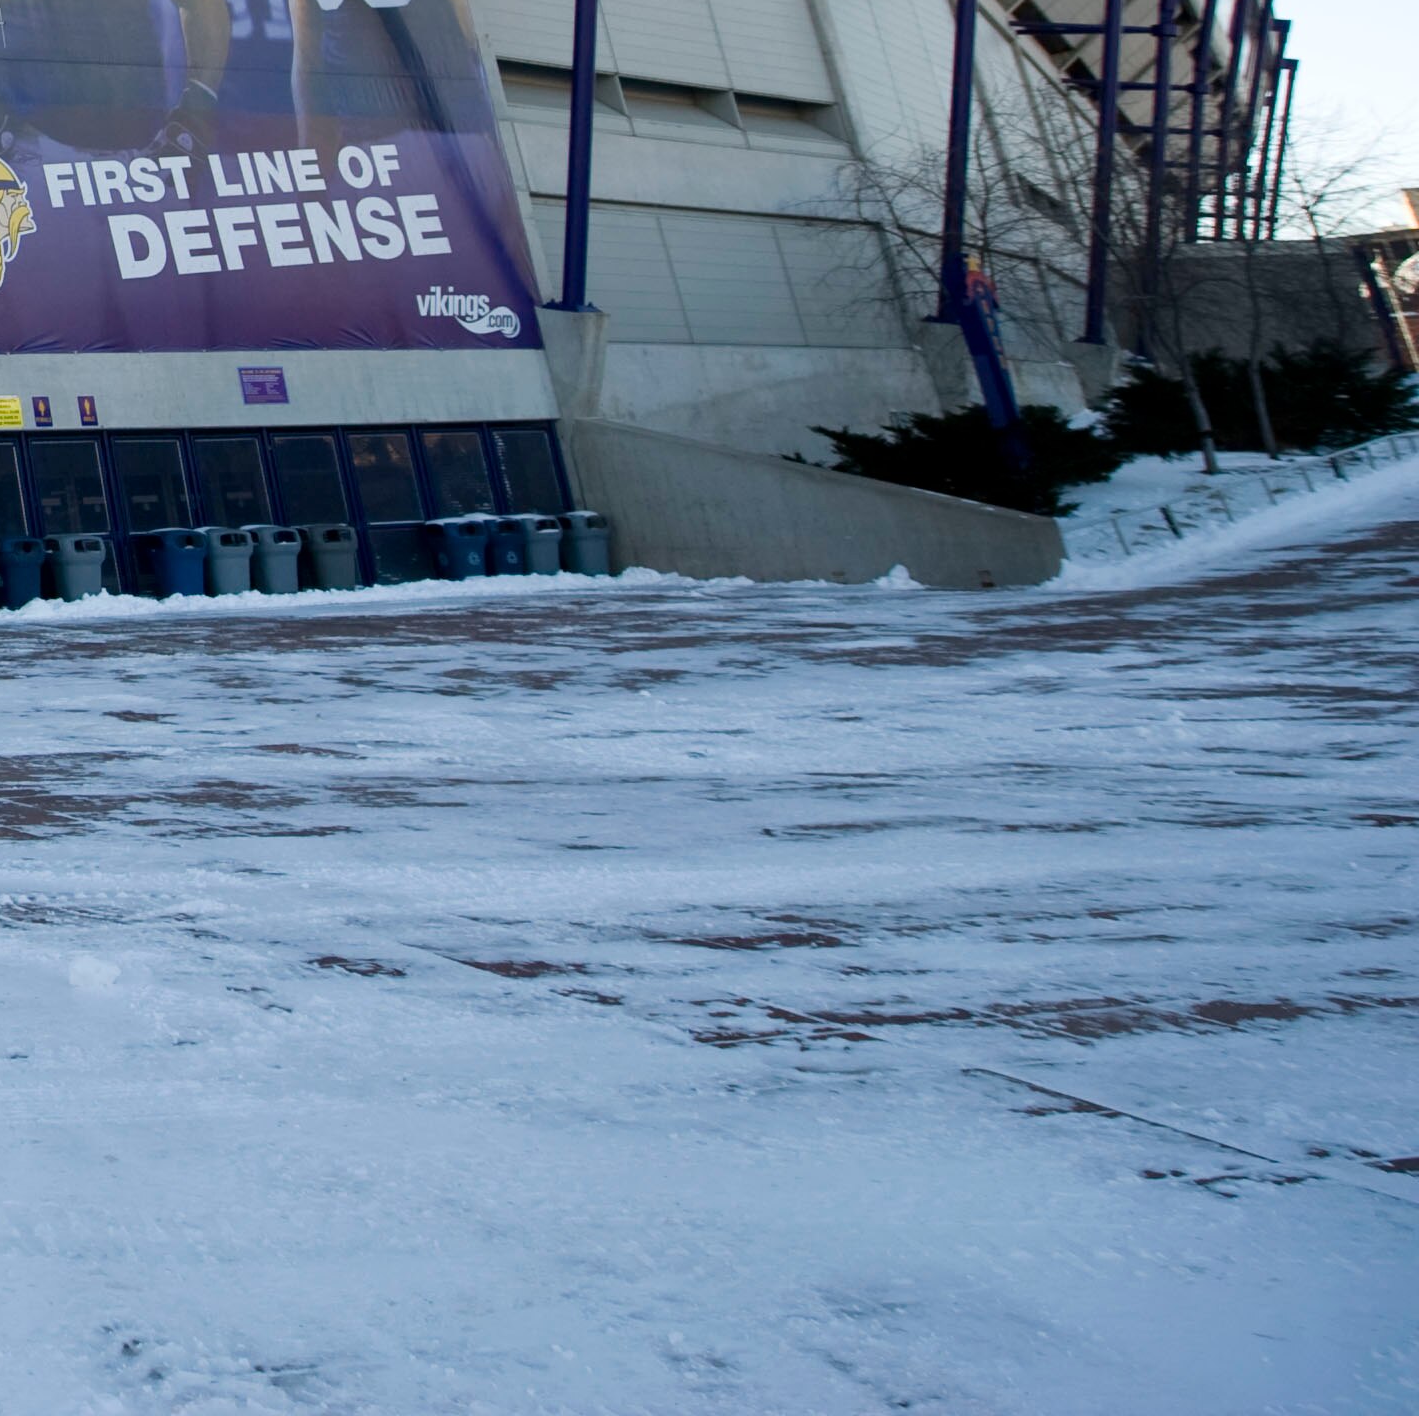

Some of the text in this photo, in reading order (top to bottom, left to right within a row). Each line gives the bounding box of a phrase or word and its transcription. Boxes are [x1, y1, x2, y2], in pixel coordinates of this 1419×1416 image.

[43, 144, 400, 208] FIRST LINE OF
[107, 194, 452, 279] DEFENSE
